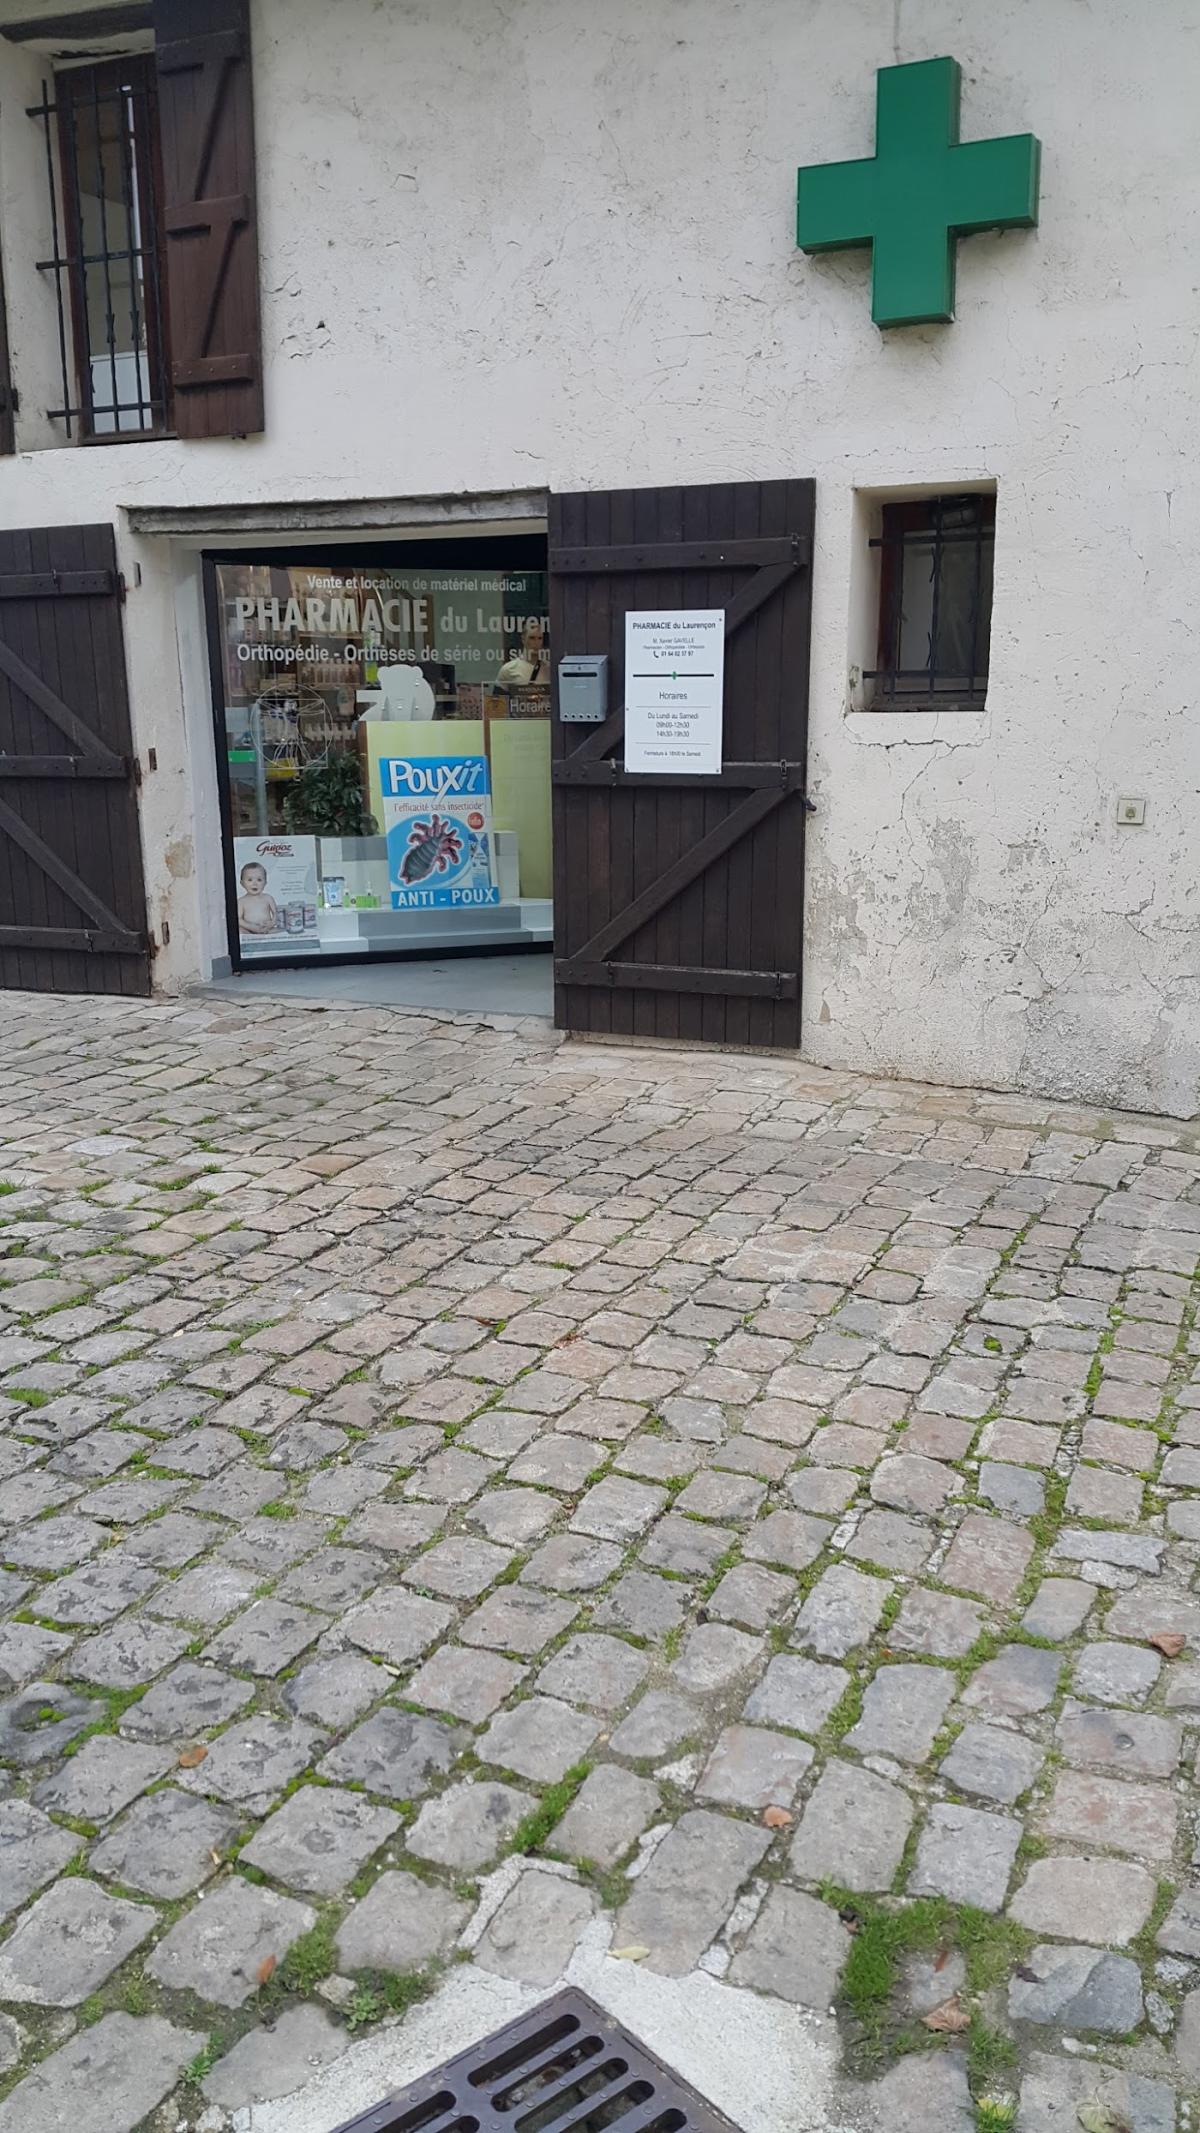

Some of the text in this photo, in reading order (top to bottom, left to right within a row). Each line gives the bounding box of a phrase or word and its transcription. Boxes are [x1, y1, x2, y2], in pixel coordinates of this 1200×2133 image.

[307, 575, 527, 592] Vente et location de matériel médical
[235, 596, 429, 633] PHARMACIE
[440, 606, 468, 633] du
[632, 621, 716, 631] PHARMACIE du Laurençon
[237, 643, 329, 665] Orthopédie
[344, 643, 416, 662] Orthèses
[420, 645, 439, 662] de
[443, 645, 481, 662] série
[486, 649, 505, 662] ou
[509, 648, 533, 661] sur
[659, 691, 688, 700] Horaires
[679, 712, 699, 720] Samedi
[388, 760, 483, 802] Pouxit
[431, 802, 446, 811] sans
[398, 890, 435, 907] ANTI
[452, 887, 495, 904] POUX
